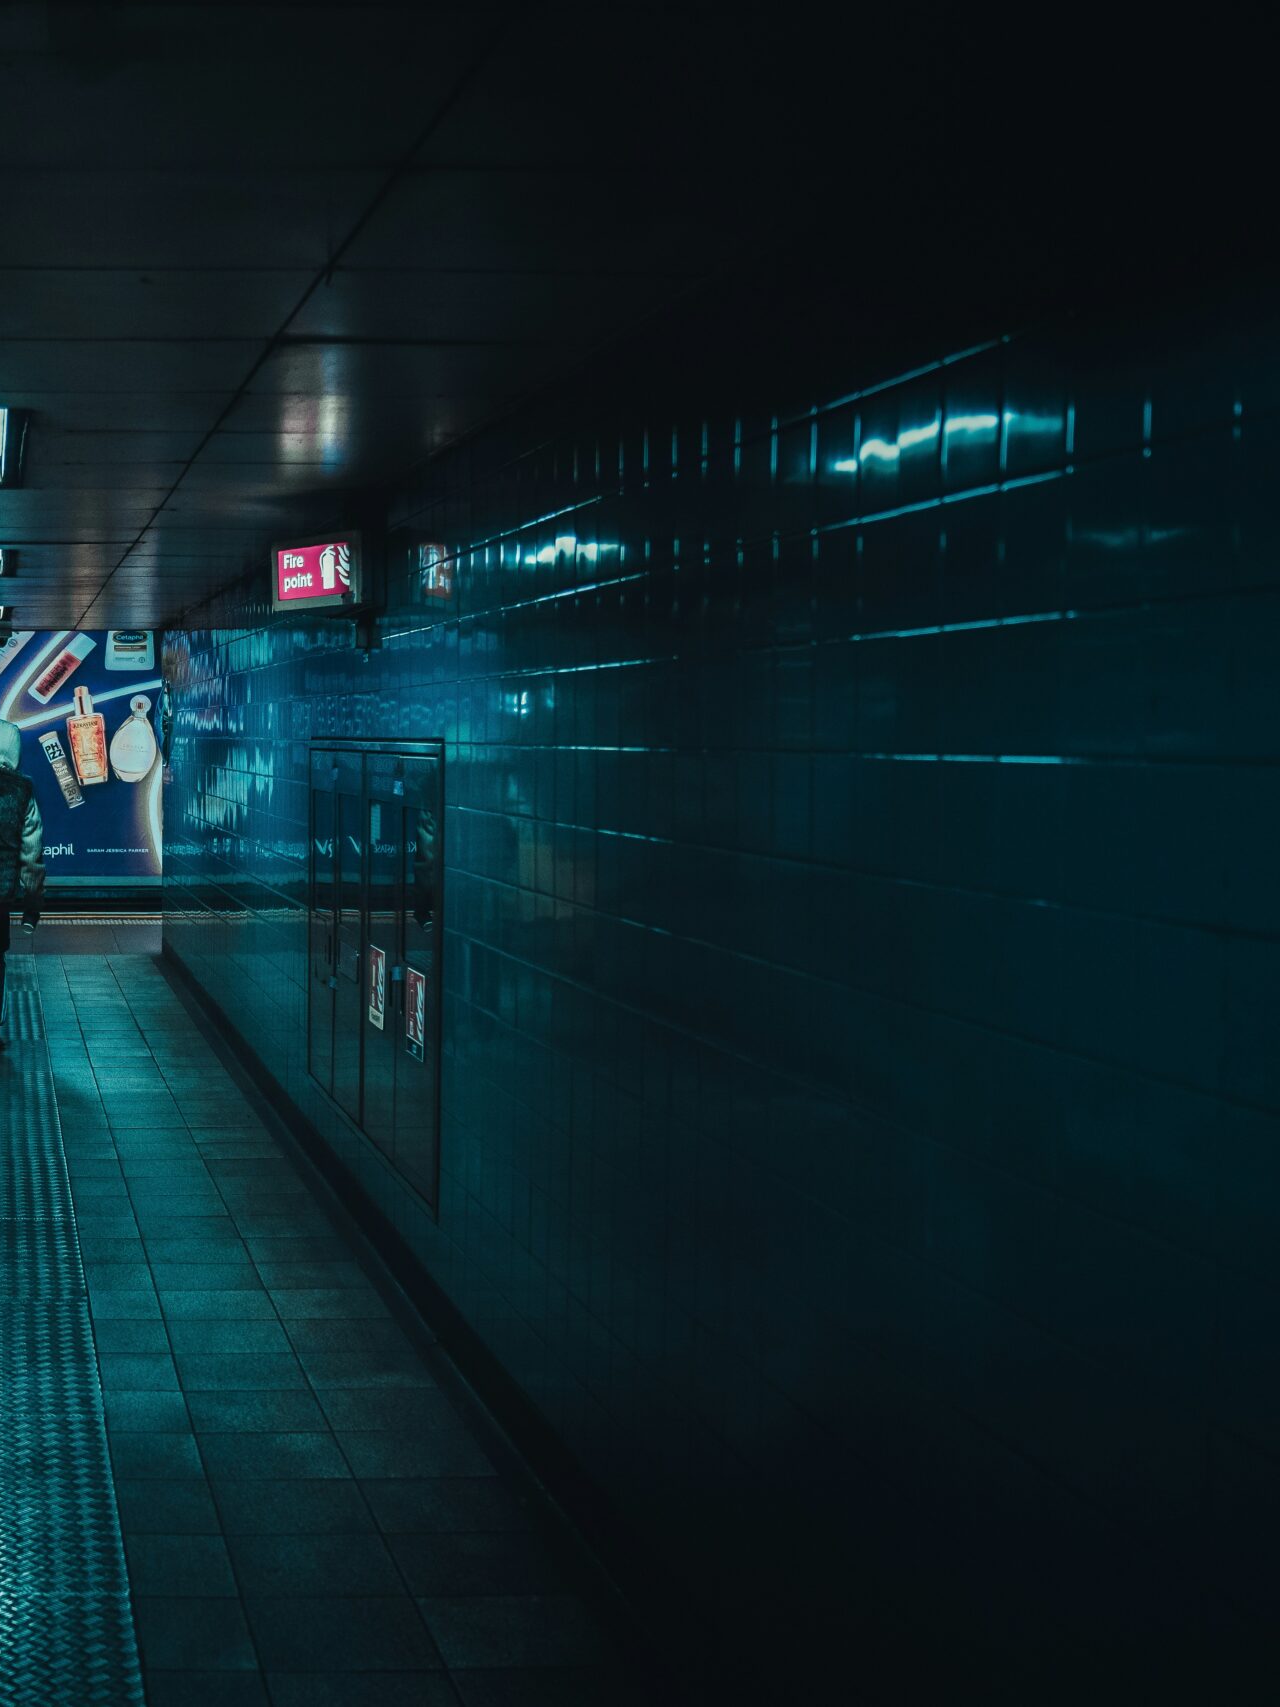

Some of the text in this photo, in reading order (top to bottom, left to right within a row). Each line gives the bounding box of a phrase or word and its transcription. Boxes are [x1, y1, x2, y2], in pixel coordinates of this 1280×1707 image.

[284, 554, 304, 569] Fire
[284, 573, 312, 592] point
[42, 843, 74, 858] aphil
